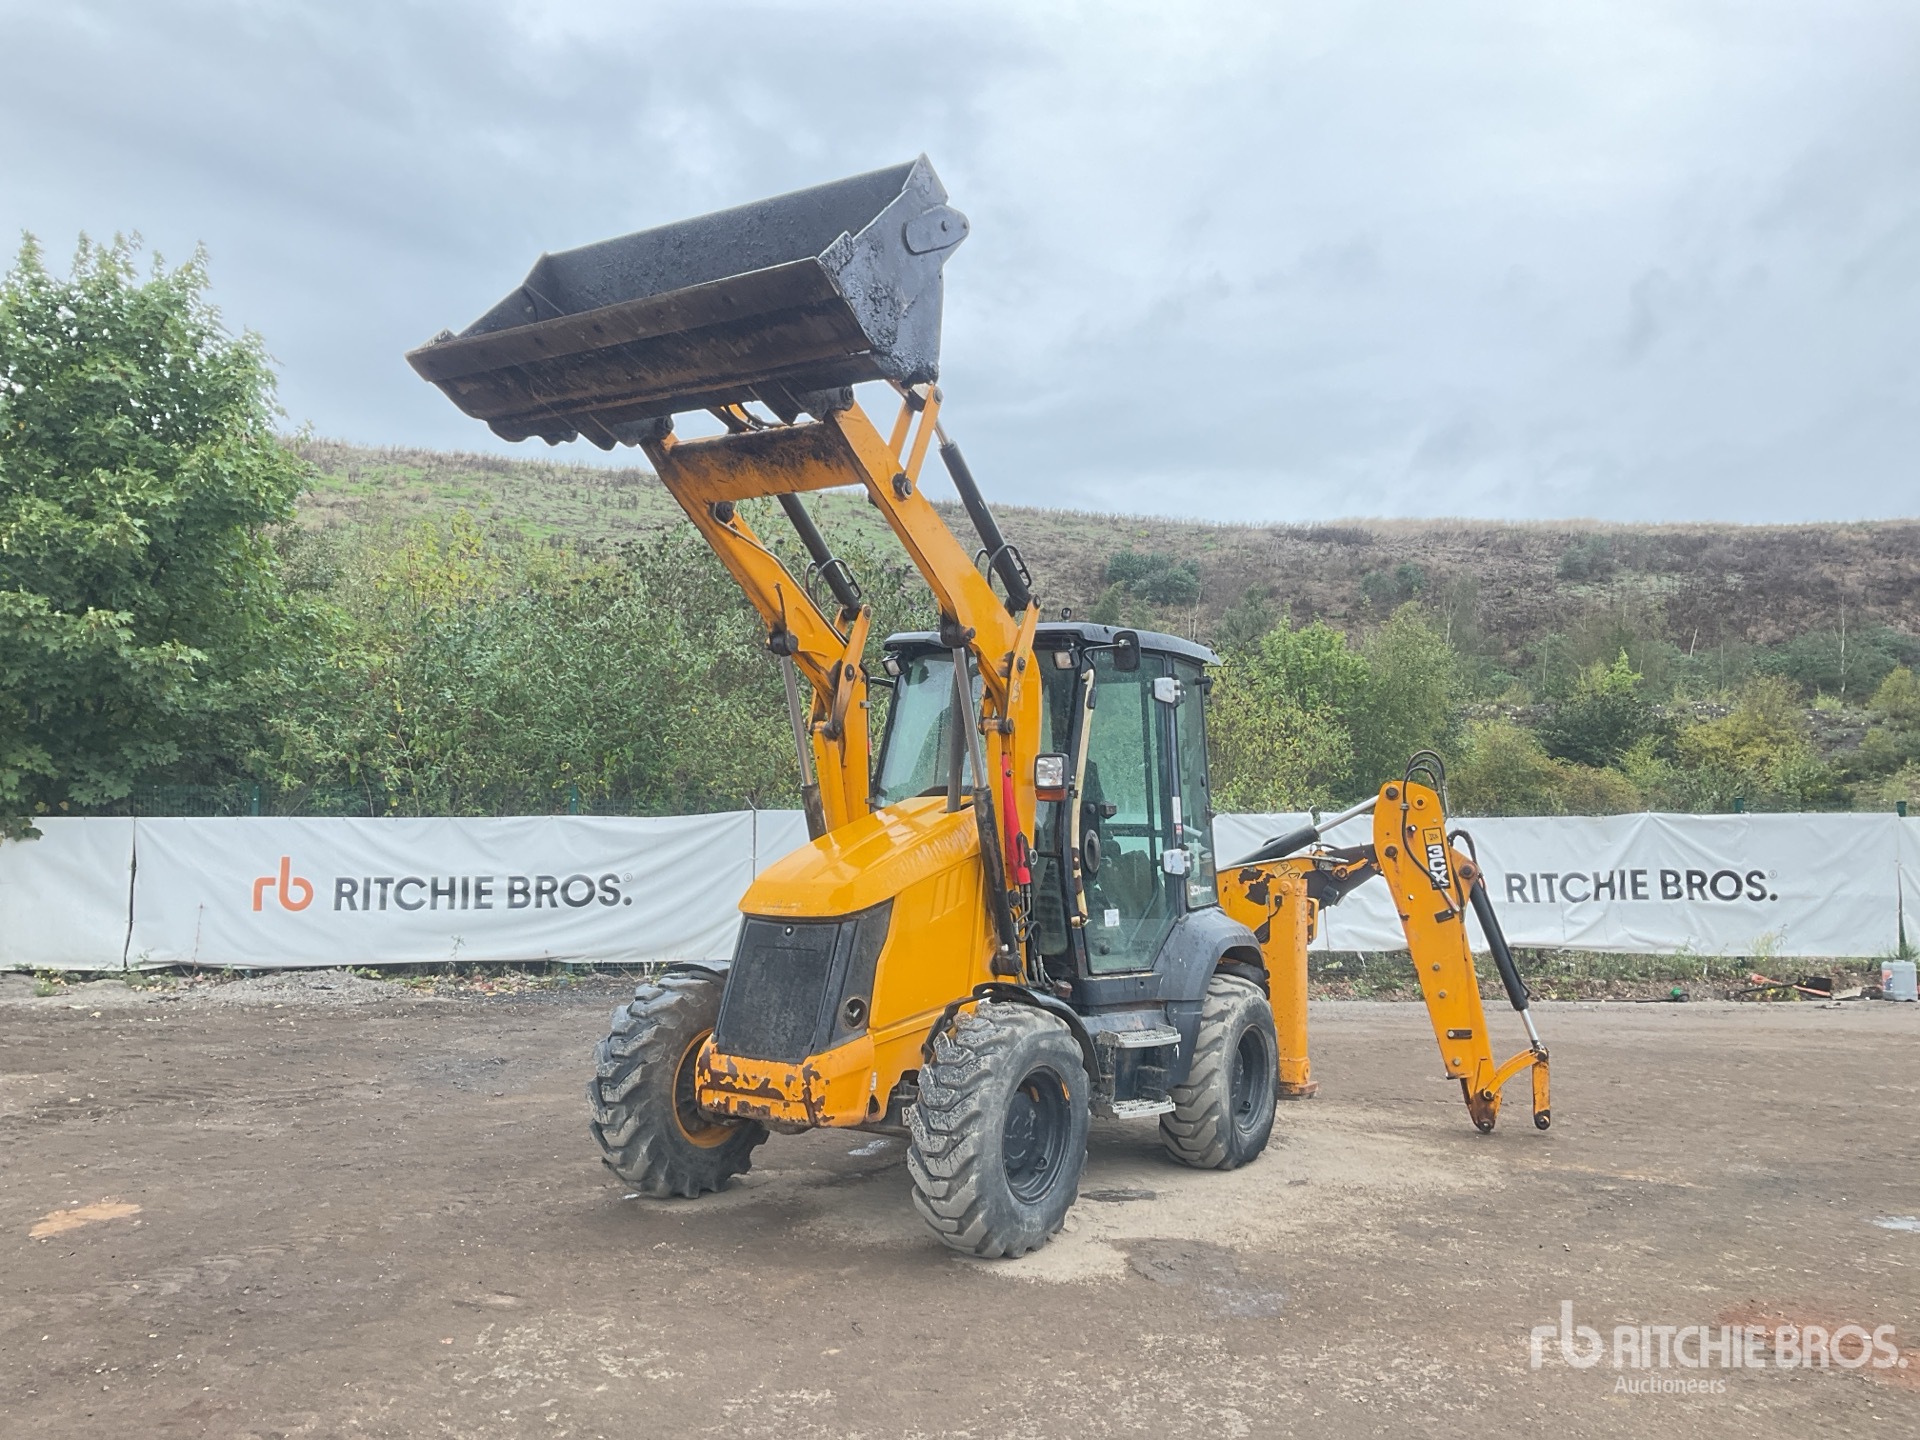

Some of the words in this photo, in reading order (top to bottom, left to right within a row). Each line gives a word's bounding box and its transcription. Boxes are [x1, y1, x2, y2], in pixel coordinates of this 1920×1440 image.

[252, 856, 314, 912] rb
[333, 876, 494, 911] RITCHIE
[507, 873, 633, 909] BROS.
[1427, 844, 1450, 885] 3CX
[1504, 869, 1650, 904] RITCHIE
[1659, 869, 1779, 902] BROS.
